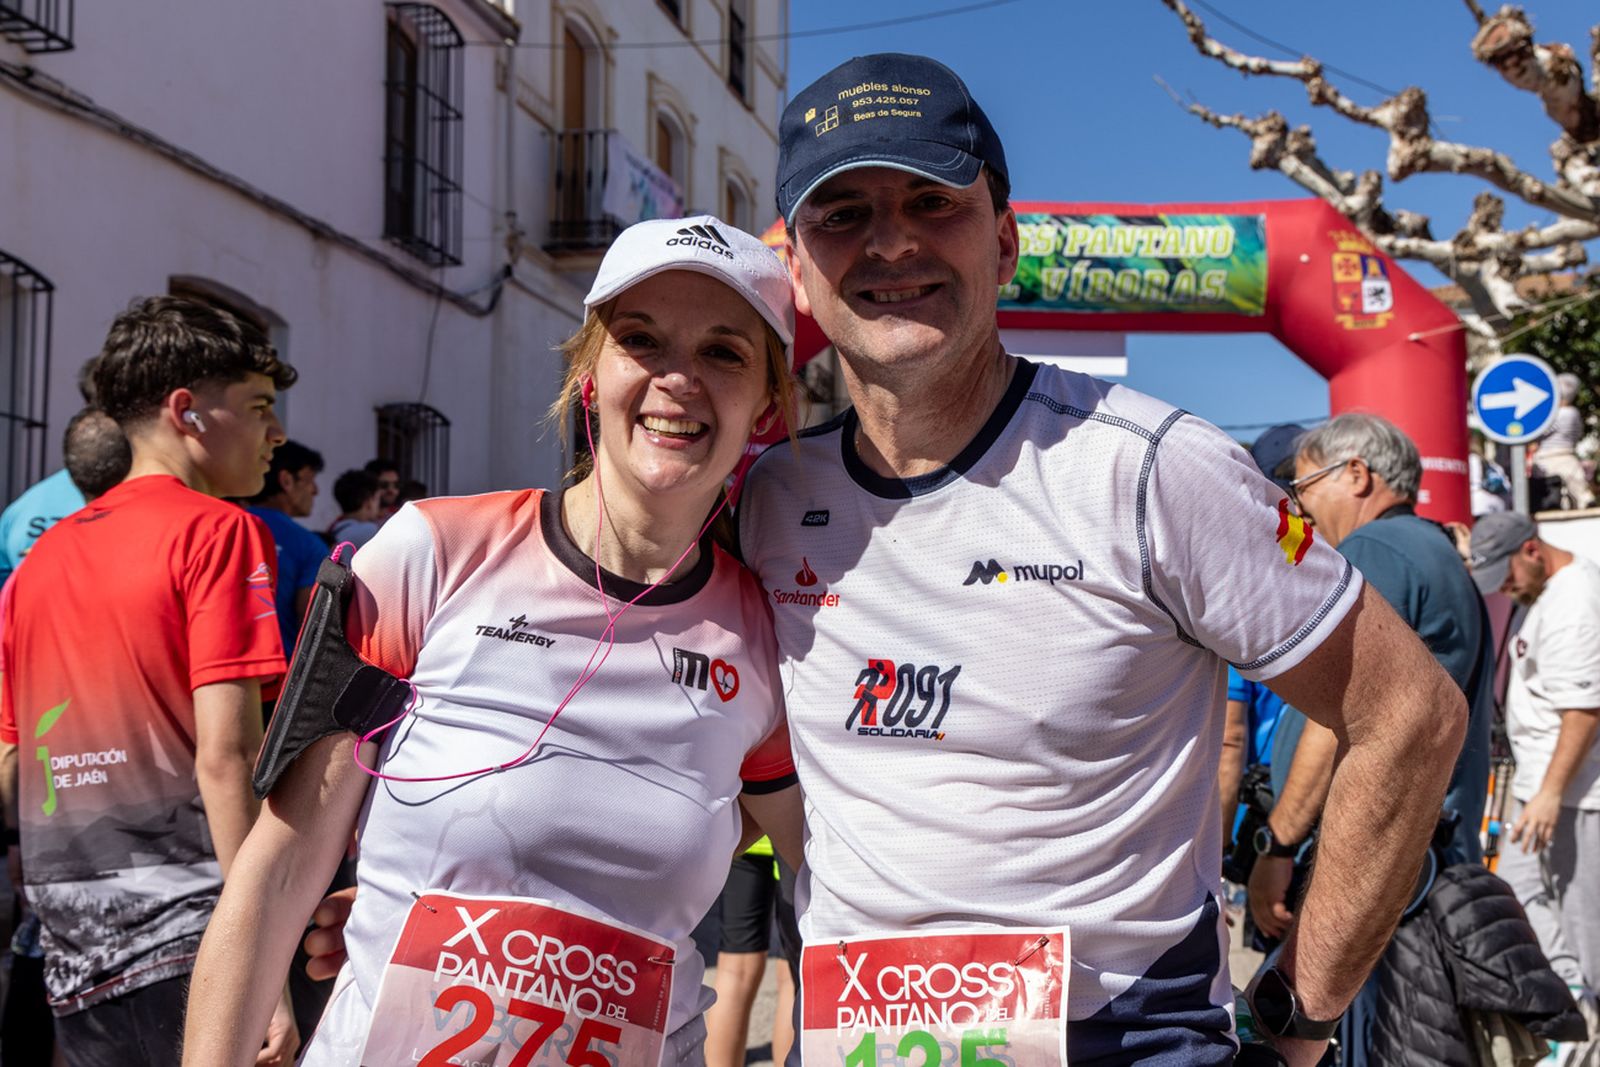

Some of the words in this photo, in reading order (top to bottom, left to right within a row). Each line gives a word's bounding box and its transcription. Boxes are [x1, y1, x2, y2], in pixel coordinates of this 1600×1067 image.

[838, 82, 889, 100] muebles
[891, 83, 931, 96] alonso
[852, 96, 920, 108] 953.425.057
[853, 111, 876, 122] Beas
[877, 109, 889, 117] de
[890, 109, 922, 119] Segura
[666, 236, 734, 259] adidas
[1063, 224, 1235, 258] PANTANO
[1042, 260, 1227, 301] VÍBORAS
[1013, 559, 1084, 585] mupol
[773, 589, 840, 607] Santander
[475, 625, 556, 648] TEAMERGY
[857, 727, 940, 739] SOLIDARIA
[50, 747, 128, 771] DIPUTACIÓN
[53, 773, 72, 789] DE
[74, 768, 108, 787] JAÉN
[442, 906, 500, 955] X
[501, 929, 638, 997] CROSS
[433, 951, 602, 1020] PANTANO
[605, 1002, 629, 1022] DEL
[837, 952, 871, 1002] X
[877, 961, 1015, 1001] CROSS
[837, 1001, 980, 1037] PANTANO
[985, 1007, 1013, 1022] DEL
